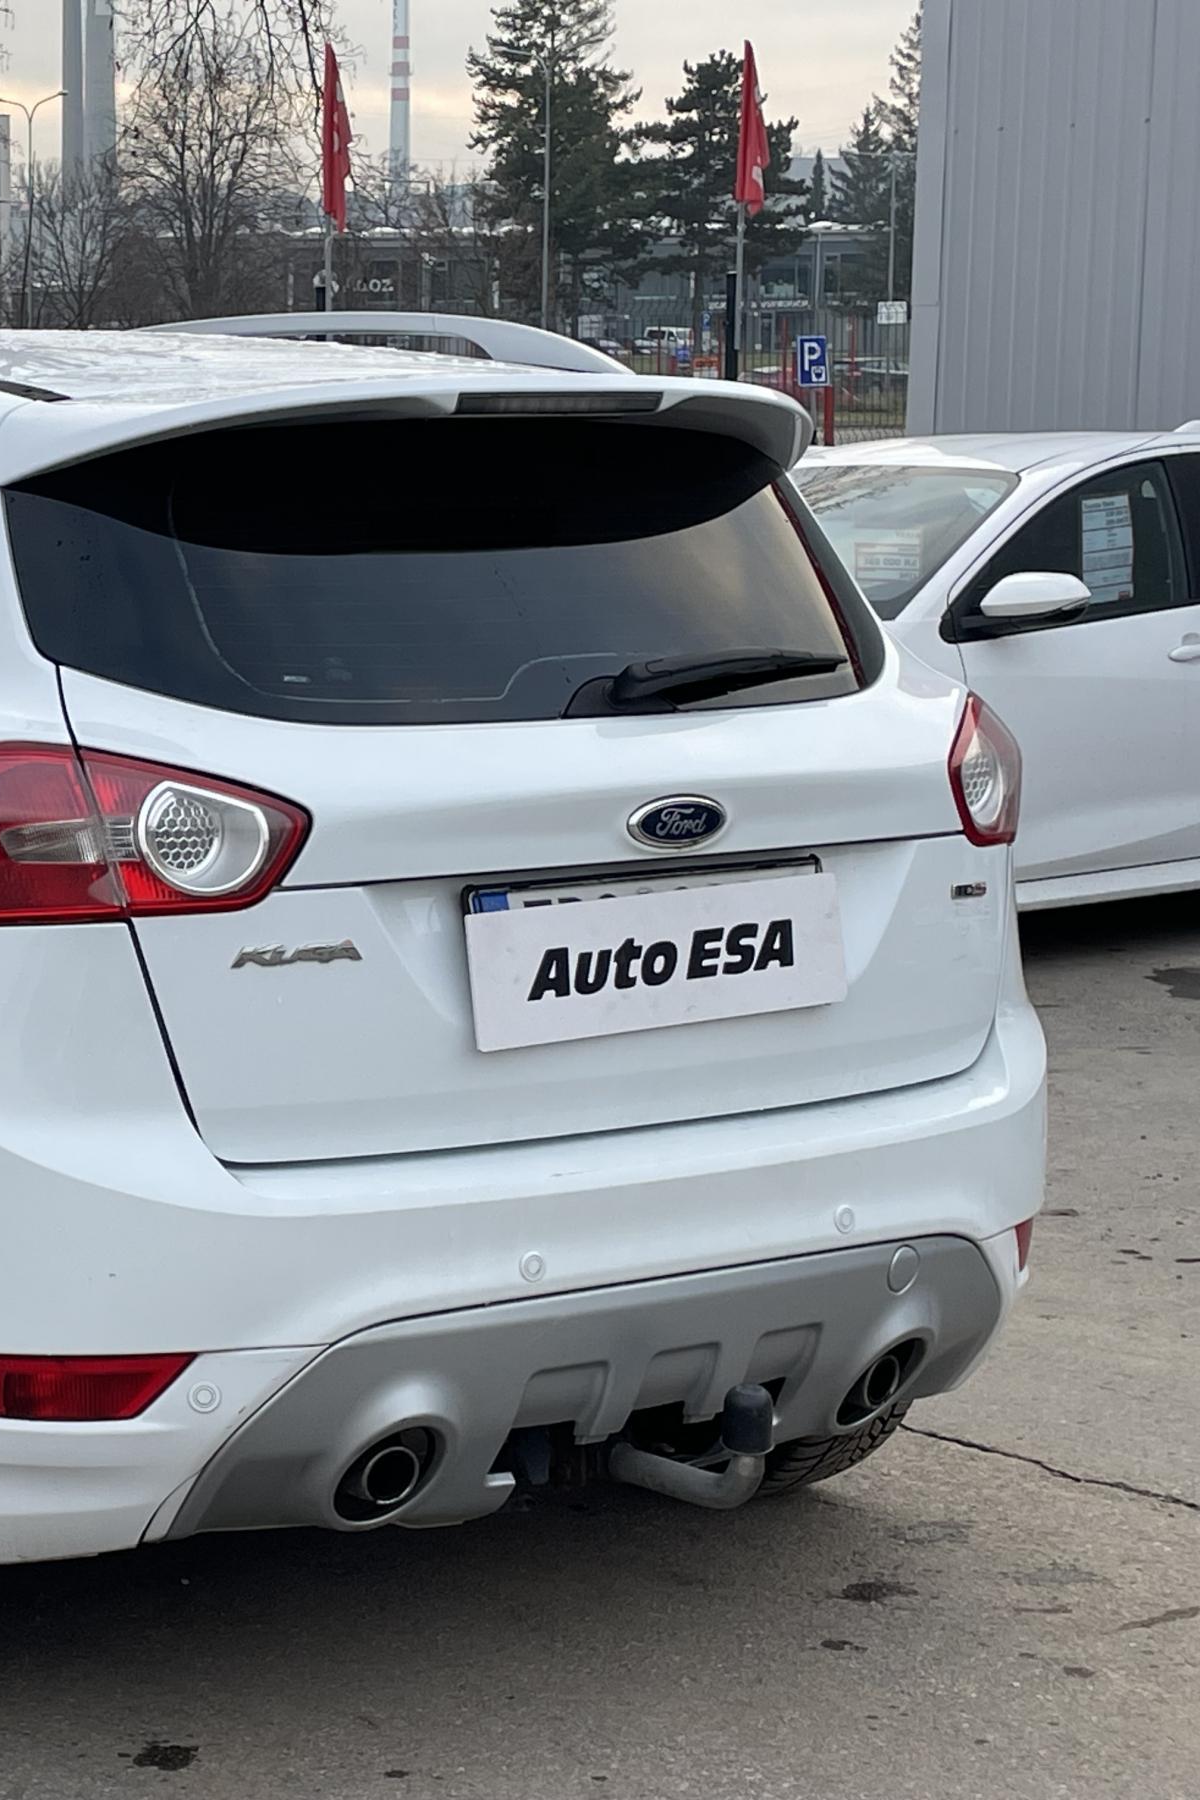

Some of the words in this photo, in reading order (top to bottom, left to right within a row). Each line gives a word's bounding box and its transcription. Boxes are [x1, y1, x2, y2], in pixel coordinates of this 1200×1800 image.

[804, 342, 821, 371] P
[656, 807, 708, 836] Ford
[231, 940, 363, 969] KUGA
[527, 938, 678, 1001] Auto
[687, 919, 794, 980] ESA
